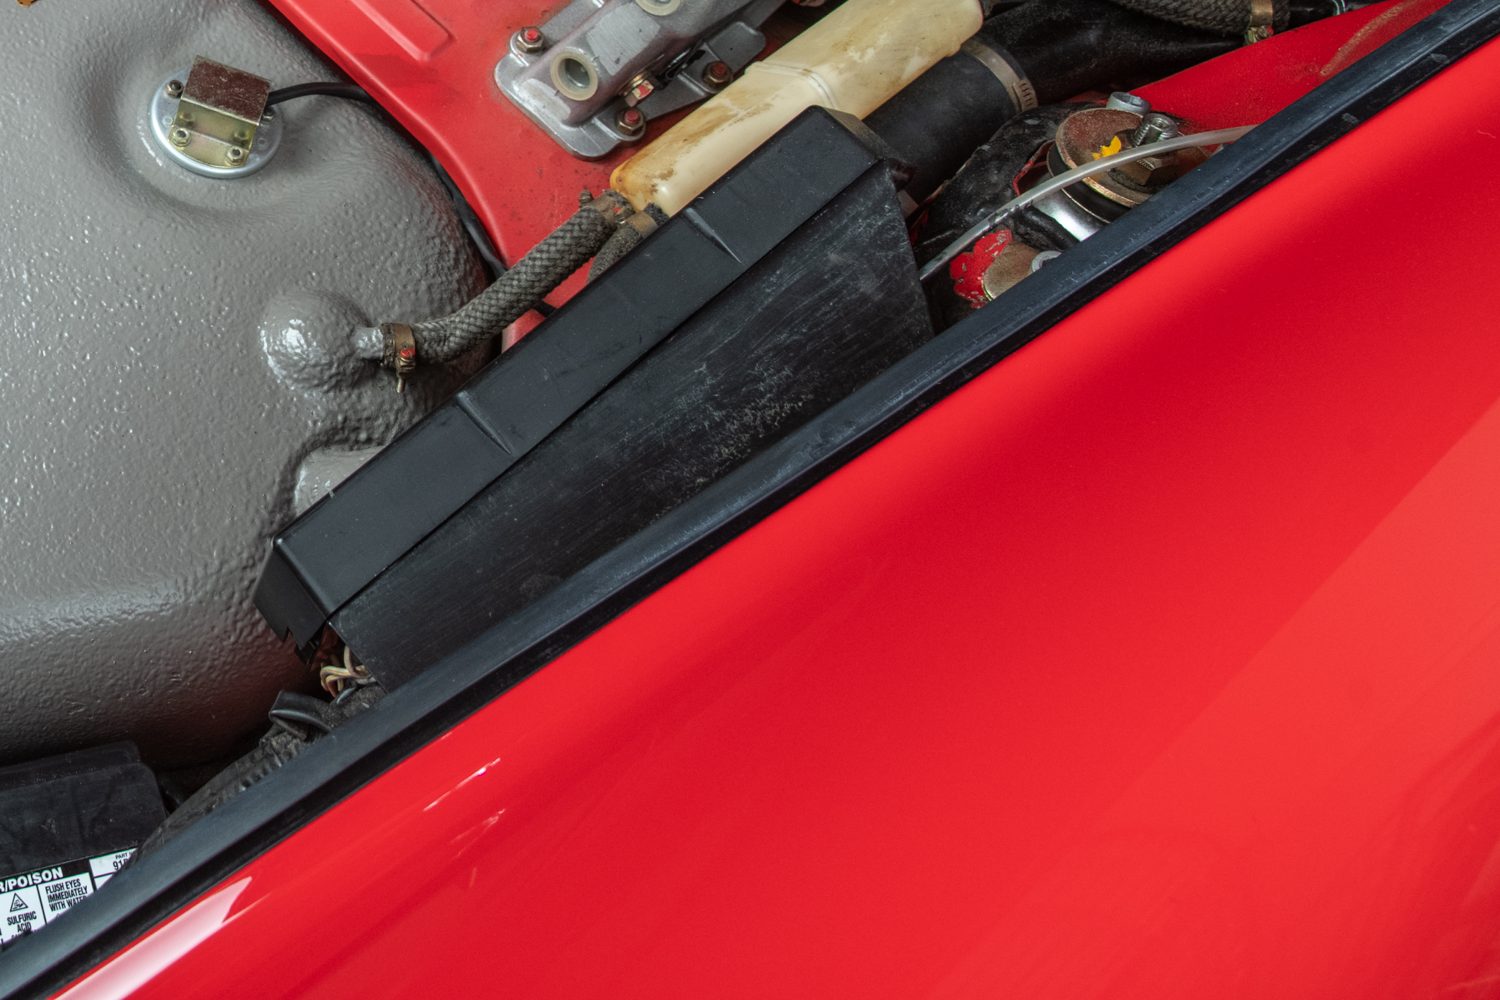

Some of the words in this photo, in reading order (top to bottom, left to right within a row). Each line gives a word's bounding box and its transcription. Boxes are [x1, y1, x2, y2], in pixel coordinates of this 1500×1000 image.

[45, 882, 64, 894] FLUSH
[65, 878, 81, 890] EYES
[48, 885, 88, 903] IMMEDIATELY
[49, 899, 67, 912] WITH
[7, 911, 37, 926] SULFURIC
[17, 921, 32, 933] ACID
